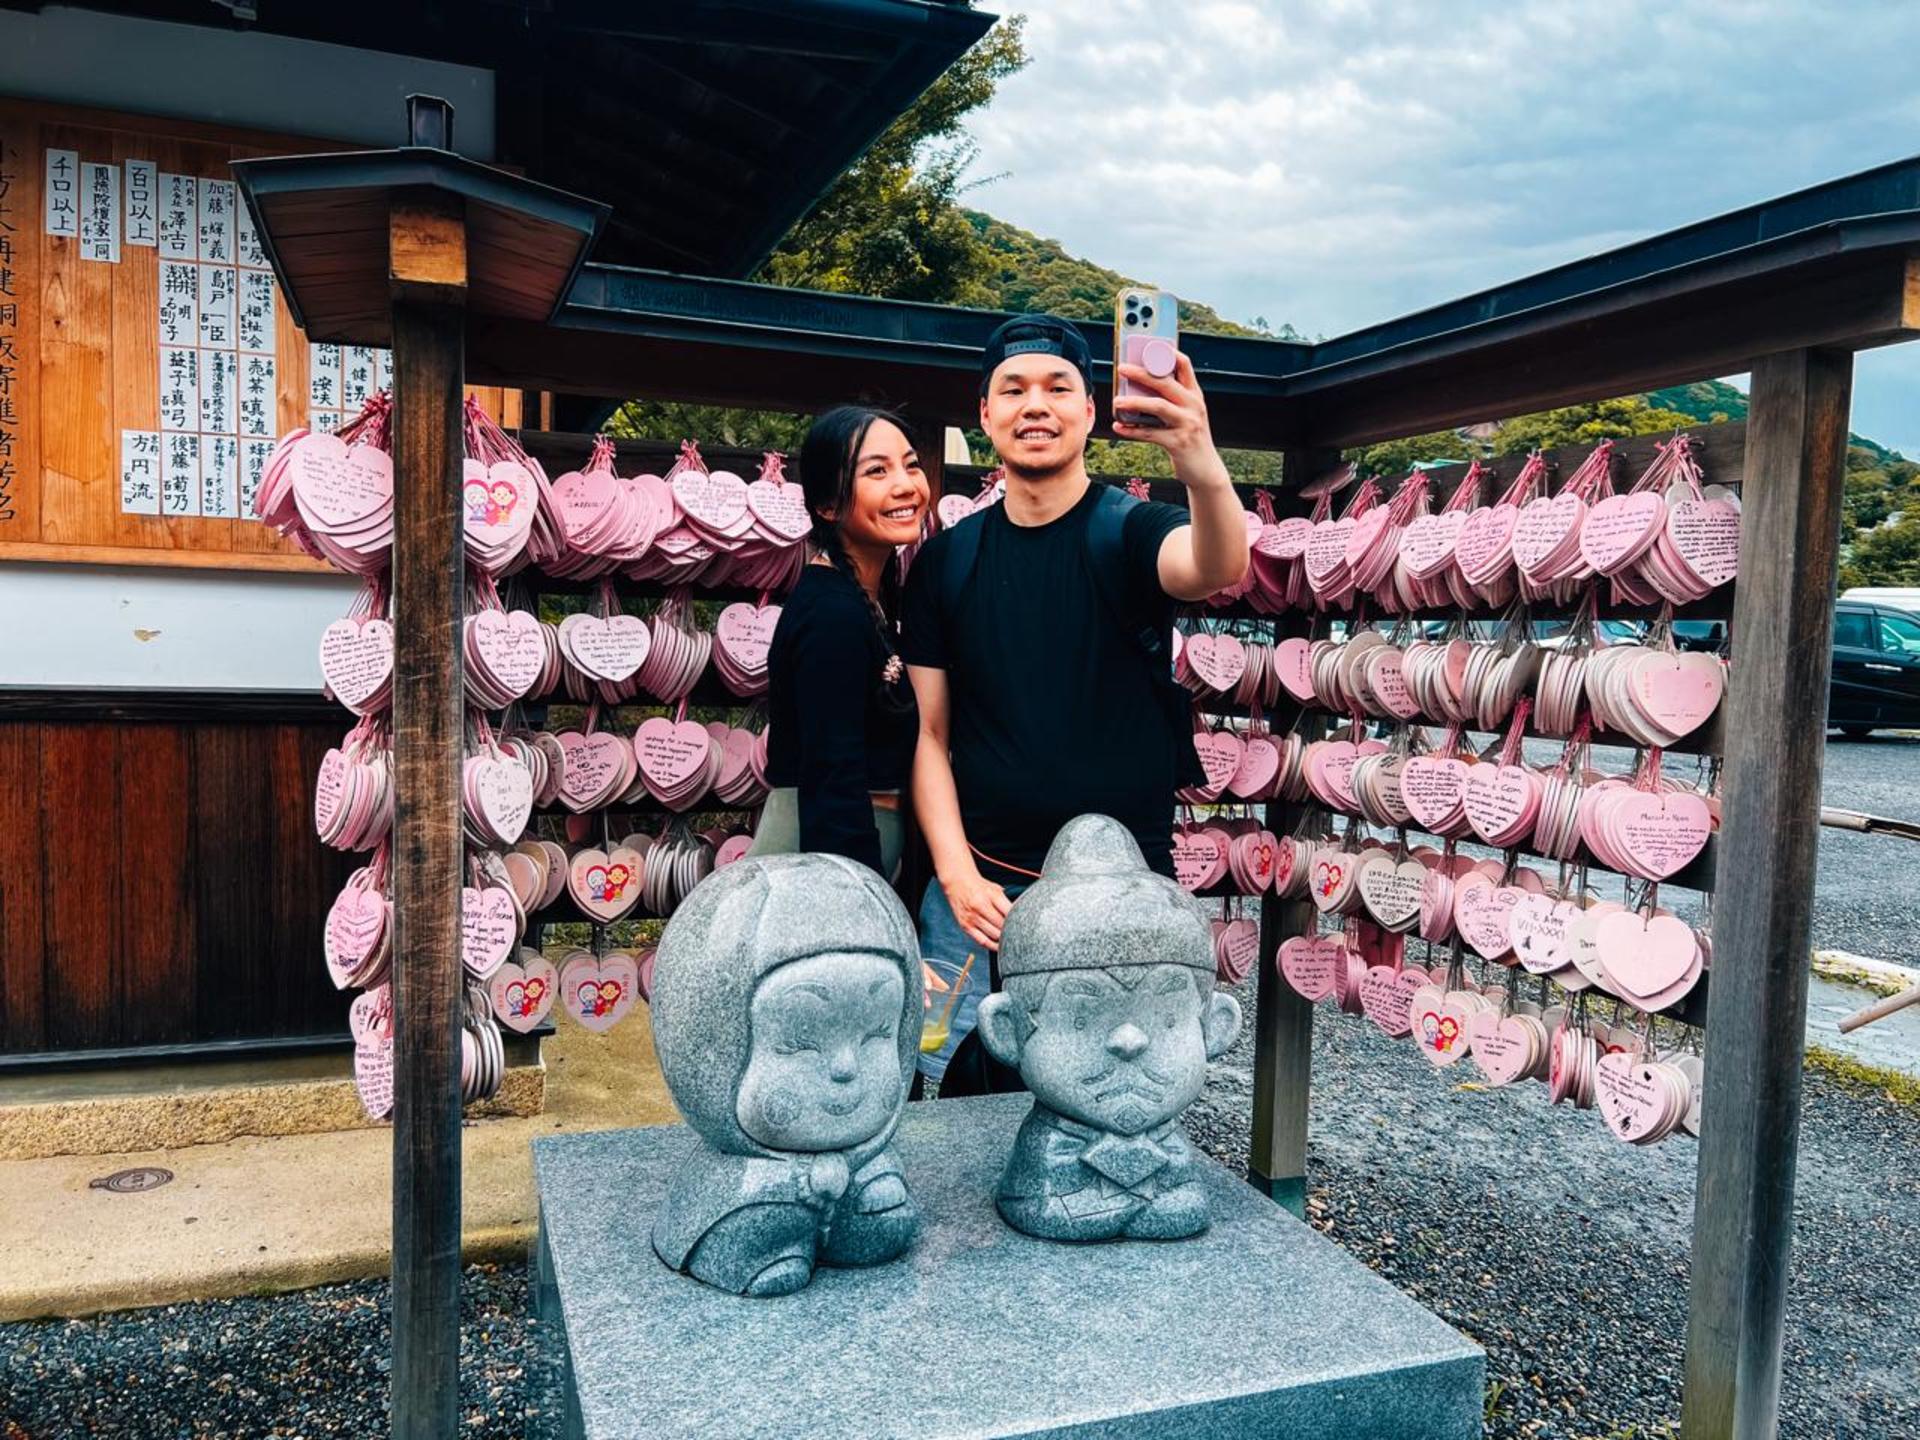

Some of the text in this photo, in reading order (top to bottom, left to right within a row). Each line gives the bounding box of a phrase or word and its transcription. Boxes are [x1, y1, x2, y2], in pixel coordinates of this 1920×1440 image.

[51, 156, 75, 232] 千口以上
[129, 166, 154, 240] 百口以上
[132, 435, 153, 500] 方円流
[171, 435, 189, 511] 後藤菊乃
